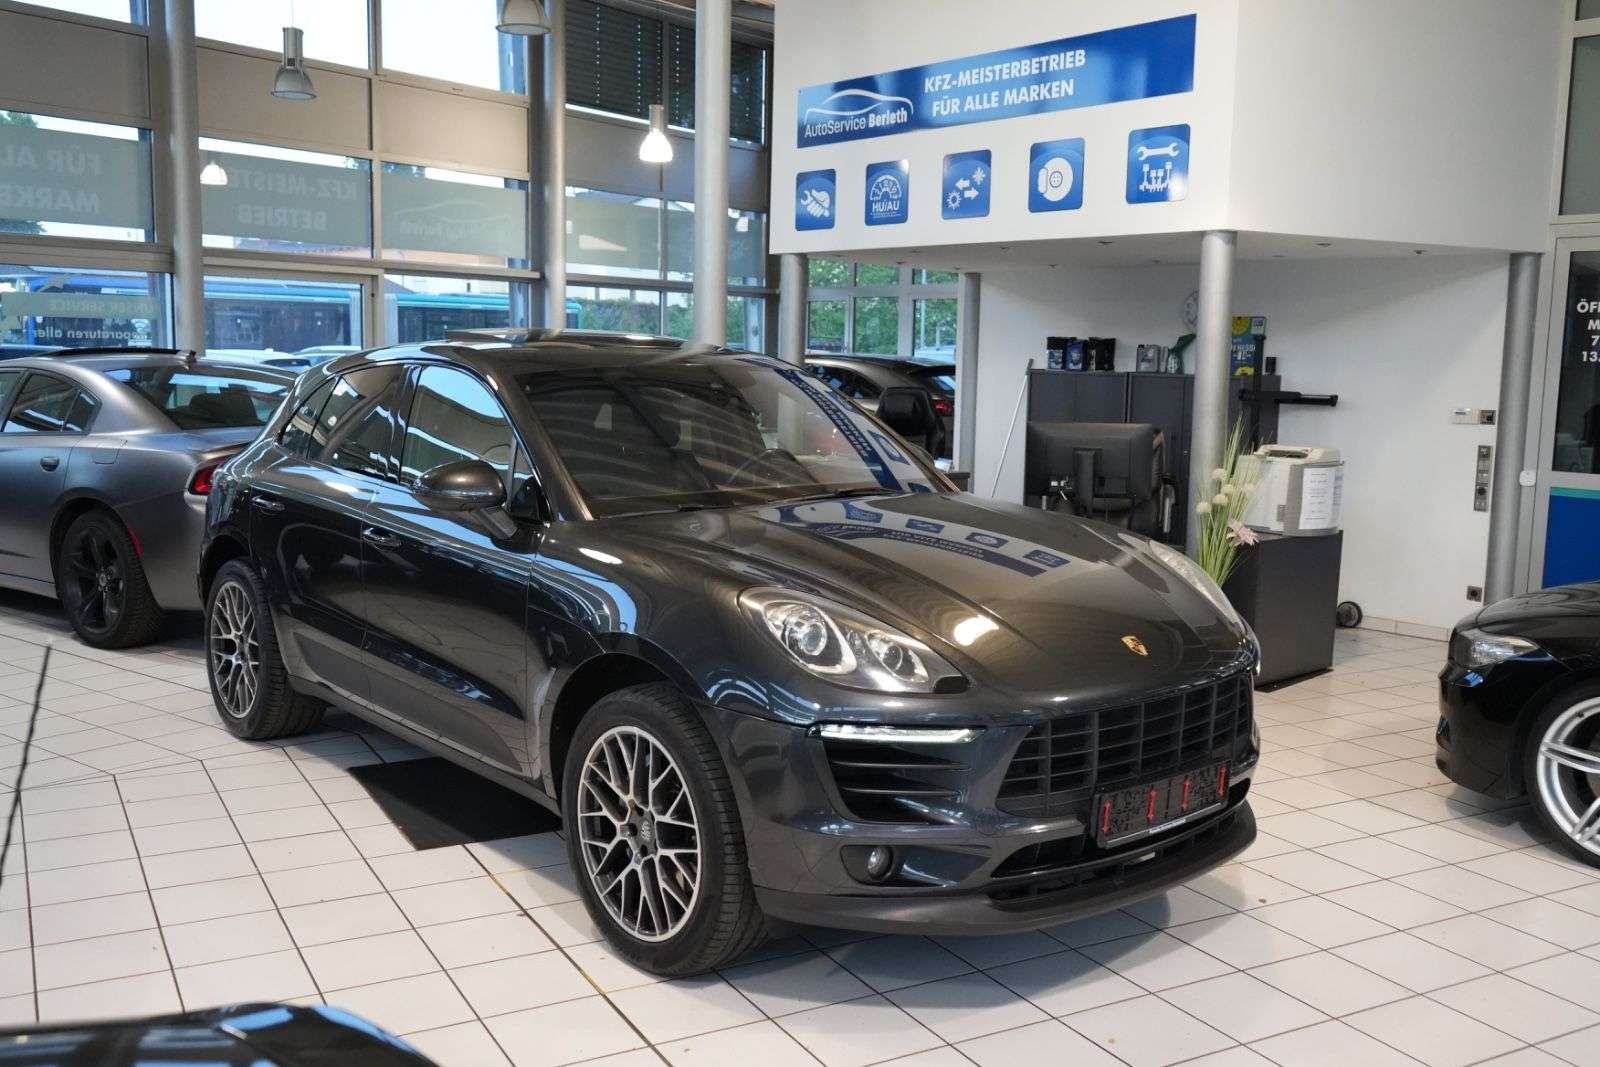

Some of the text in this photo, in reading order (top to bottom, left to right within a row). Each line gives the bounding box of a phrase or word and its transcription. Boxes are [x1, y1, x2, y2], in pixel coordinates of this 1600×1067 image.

[924, 49, 1087, 93] KFZ-MEISTERBETRIEB
[932, 79, 1075, 117] FÜR ALLE MARKEN
[804, 107, 907, 138] AutoService Berleth
[872, 200, 900, 212] HU/AU
